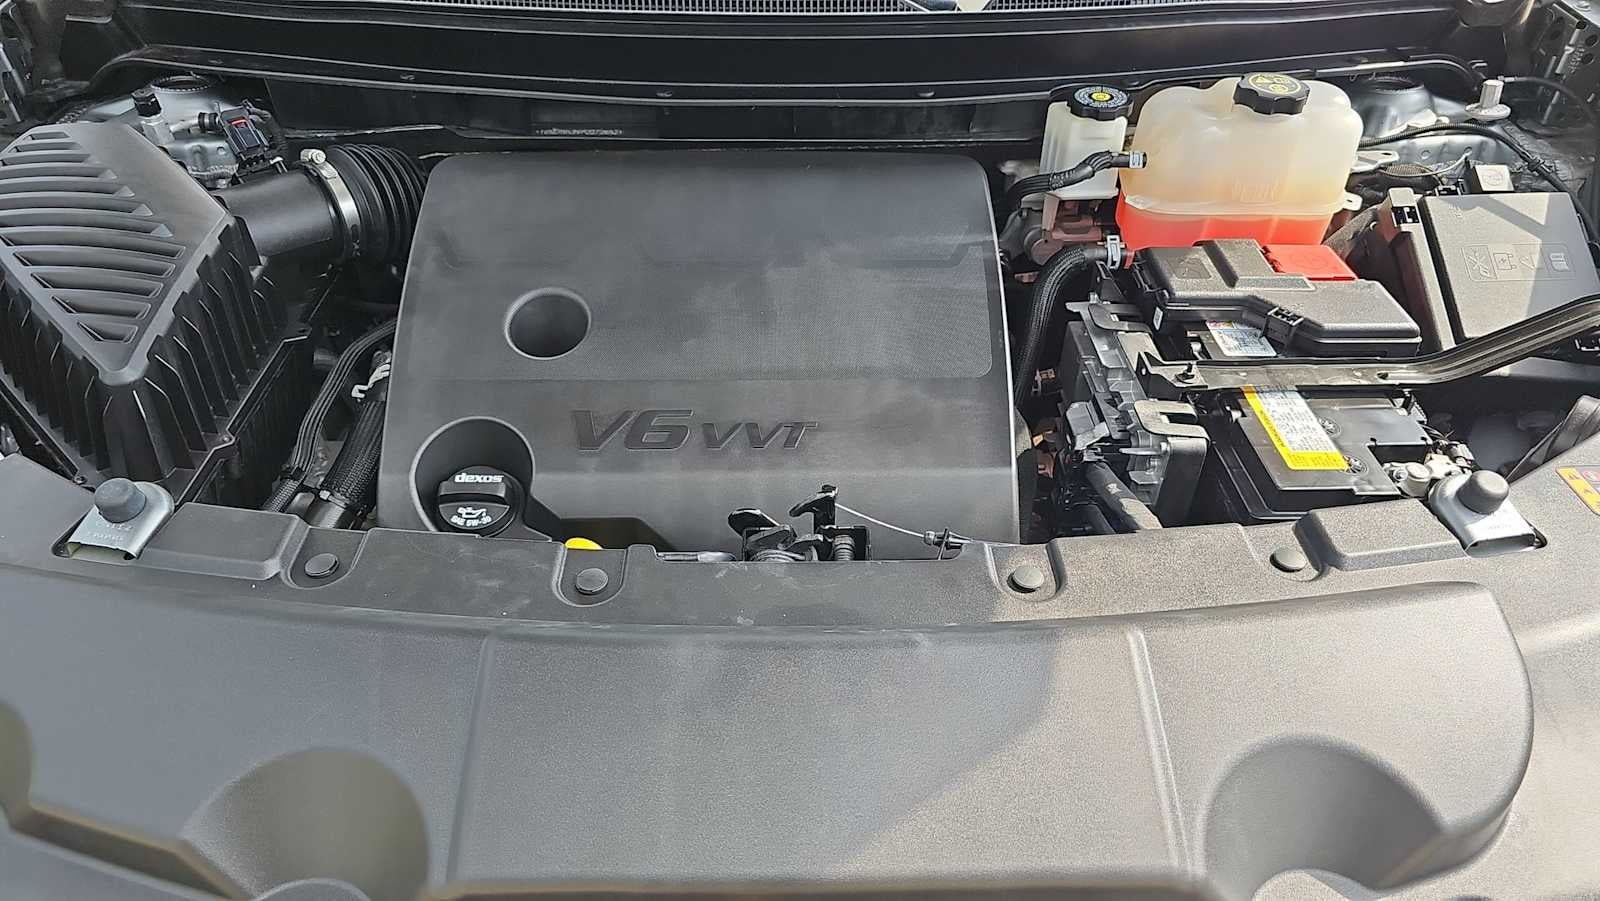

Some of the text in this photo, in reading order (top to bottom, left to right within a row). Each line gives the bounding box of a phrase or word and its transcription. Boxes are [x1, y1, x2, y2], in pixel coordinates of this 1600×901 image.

[571, 409, 818, 451] V6 VVT
[454, 472, 505, 483] dexos
